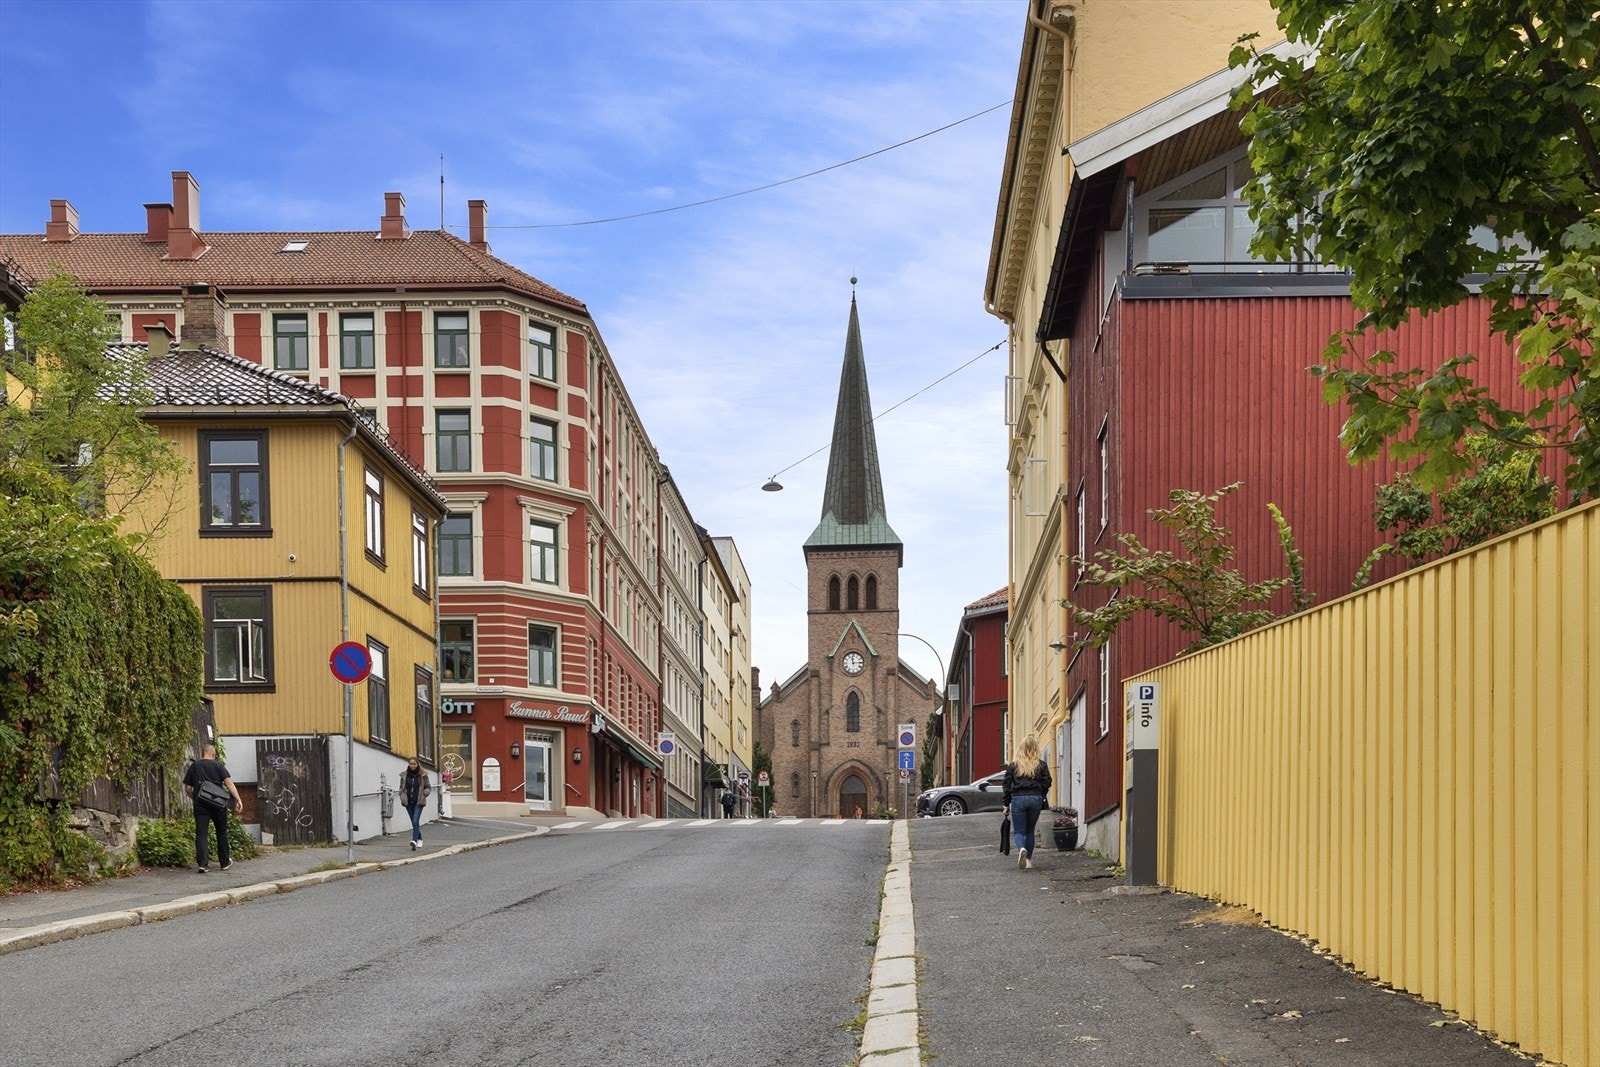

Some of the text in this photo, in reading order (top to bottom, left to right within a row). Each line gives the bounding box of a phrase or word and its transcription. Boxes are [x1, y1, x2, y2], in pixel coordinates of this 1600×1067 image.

[509, 701, 552, 719] Gunnar
[553, 706, 590, 723] Ruud
[1141, 703, 1153, 728] info
